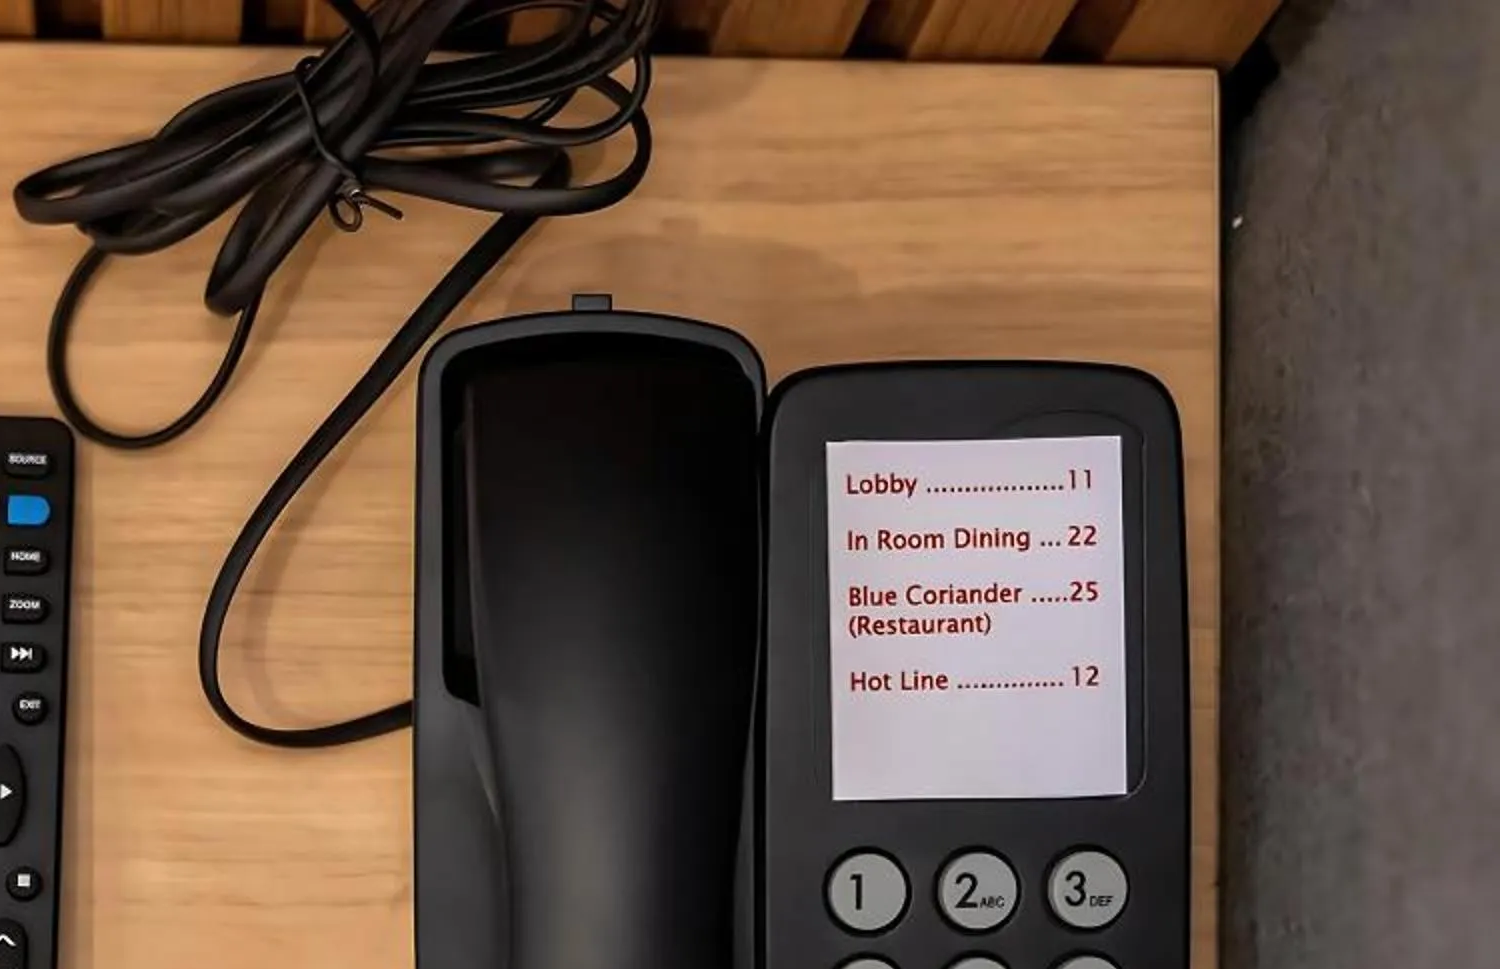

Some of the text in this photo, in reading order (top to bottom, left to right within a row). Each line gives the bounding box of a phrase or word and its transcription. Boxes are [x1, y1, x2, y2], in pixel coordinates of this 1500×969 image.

[846, 469, 1091, 499] Lobby 11
[847, 525, 1097, 552] In Room Dining 22
[9, 599, 41, 610] ZOOM
[849, 580, 1099, 607] Blue Coriander 25
[848, 612, 992, 639] (Restaurant)
[850, 665, 1099, 692] Hot Line 12
[19, 699, 41, 710] EXIT
[849, 873, 863, 911] 1
[954, 871, 1005, 909] 2 ABC
[1064, 870, 1114, 907] 3 DEF
